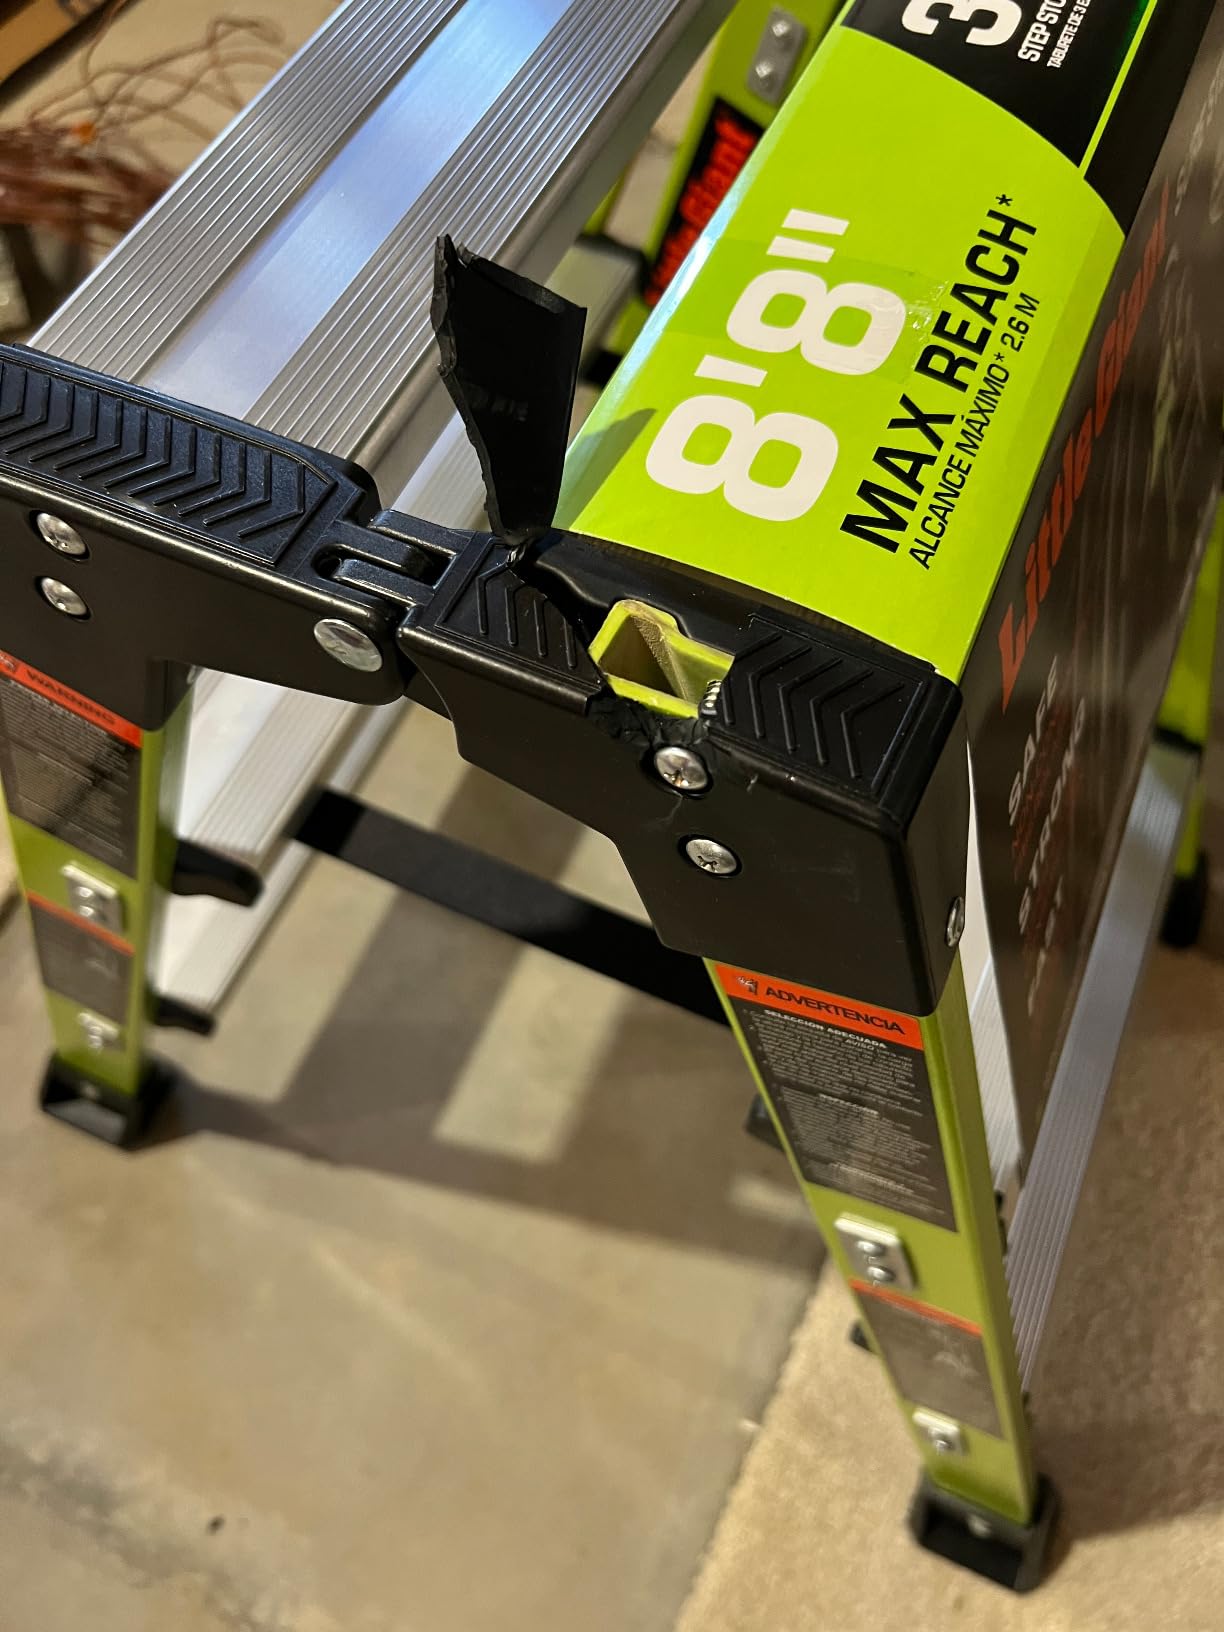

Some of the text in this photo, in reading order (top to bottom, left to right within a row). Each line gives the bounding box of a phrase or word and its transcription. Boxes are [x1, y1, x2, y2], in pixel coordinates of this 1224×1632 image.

[1017, 21, 1051, 62] STEP
[1046, 24, 1079, 68] TABURETE
[1067, 12, 1084, 27] DE
[840, 394, 956, 554] MAX
[908, 454, 973, 570] ALCANCE
[1000, 315, 1029, 353] 2.6
[1018, 294, 1041, 317] M
[998, 408, 1094, 716] Little
[1094, 177, 1169, 438] Giant
[1008, 655, 1057, 827] SAFE
[765, 985, 905, 1035] ADVERTENCIA
